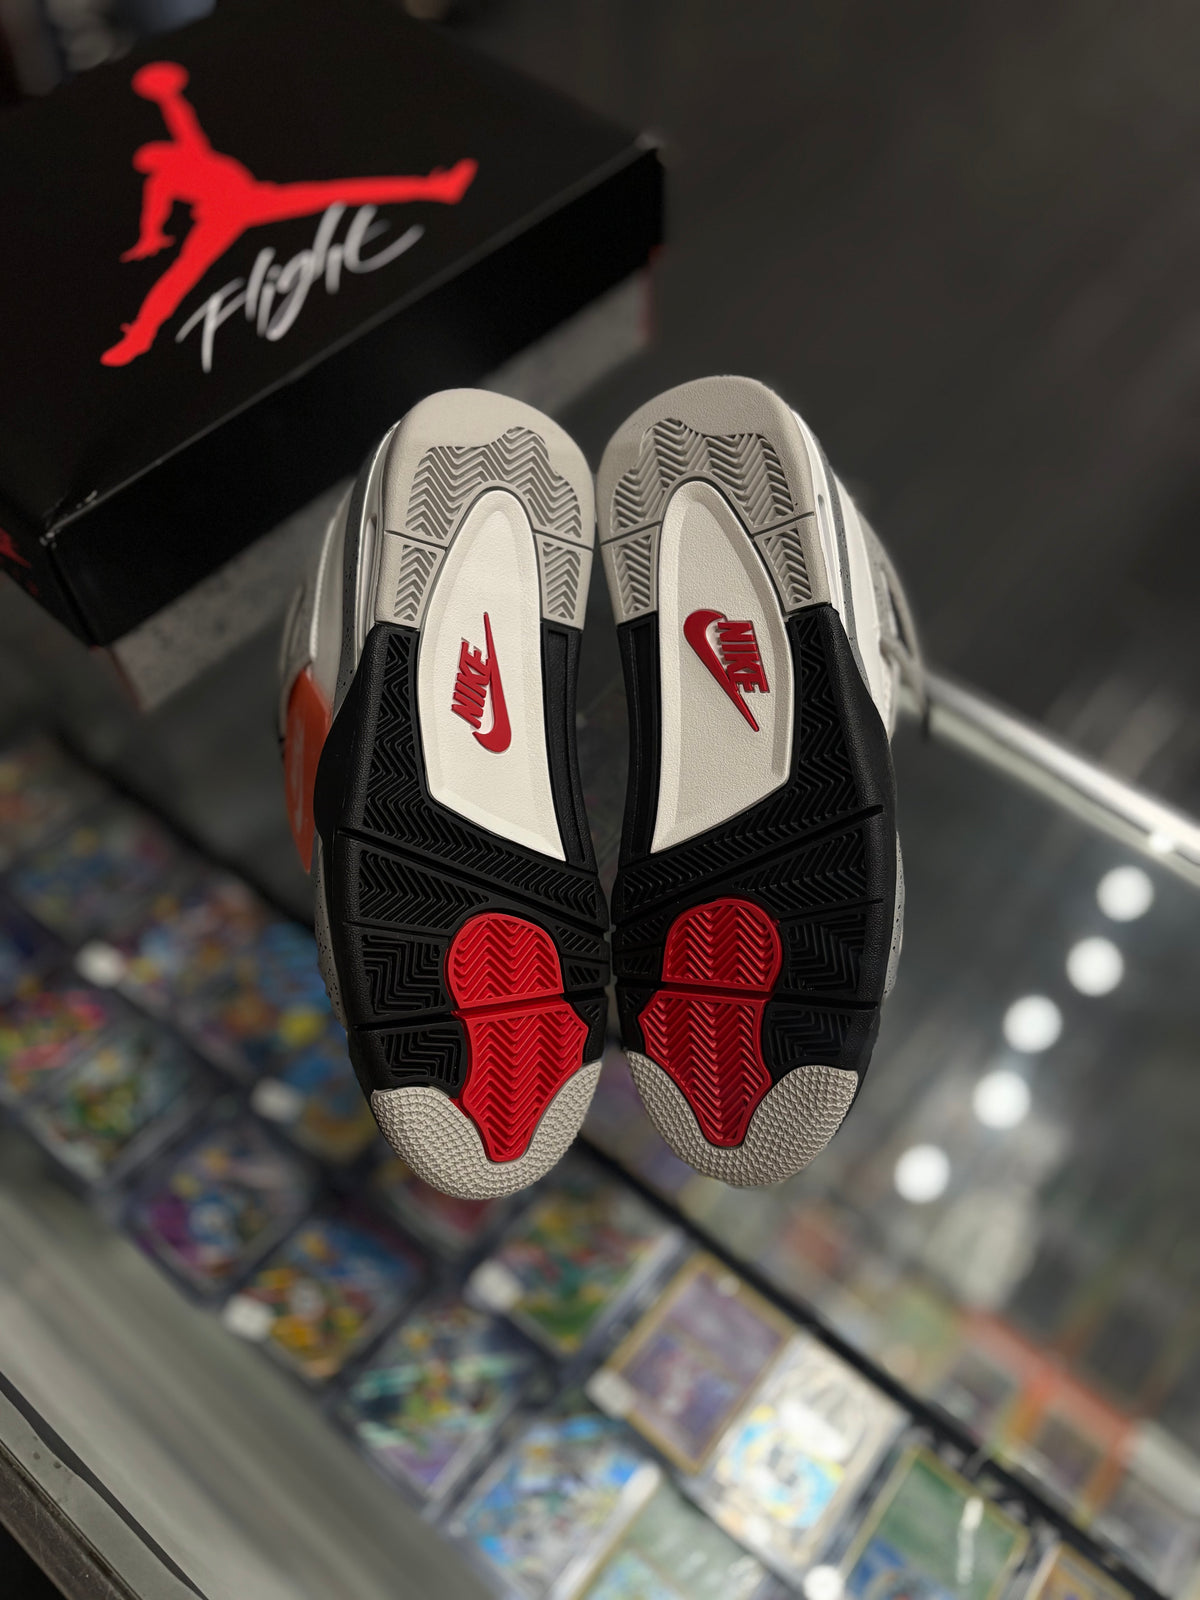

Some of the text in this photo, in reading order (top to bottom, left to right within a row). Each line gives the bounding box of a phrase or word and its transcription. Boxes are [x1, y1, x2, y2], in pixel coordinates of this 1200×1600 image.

[175, 202, 425, 373] Flight
[451, 638, 490, 729] NIKE
[716, 620, 770, 694] NIKE
